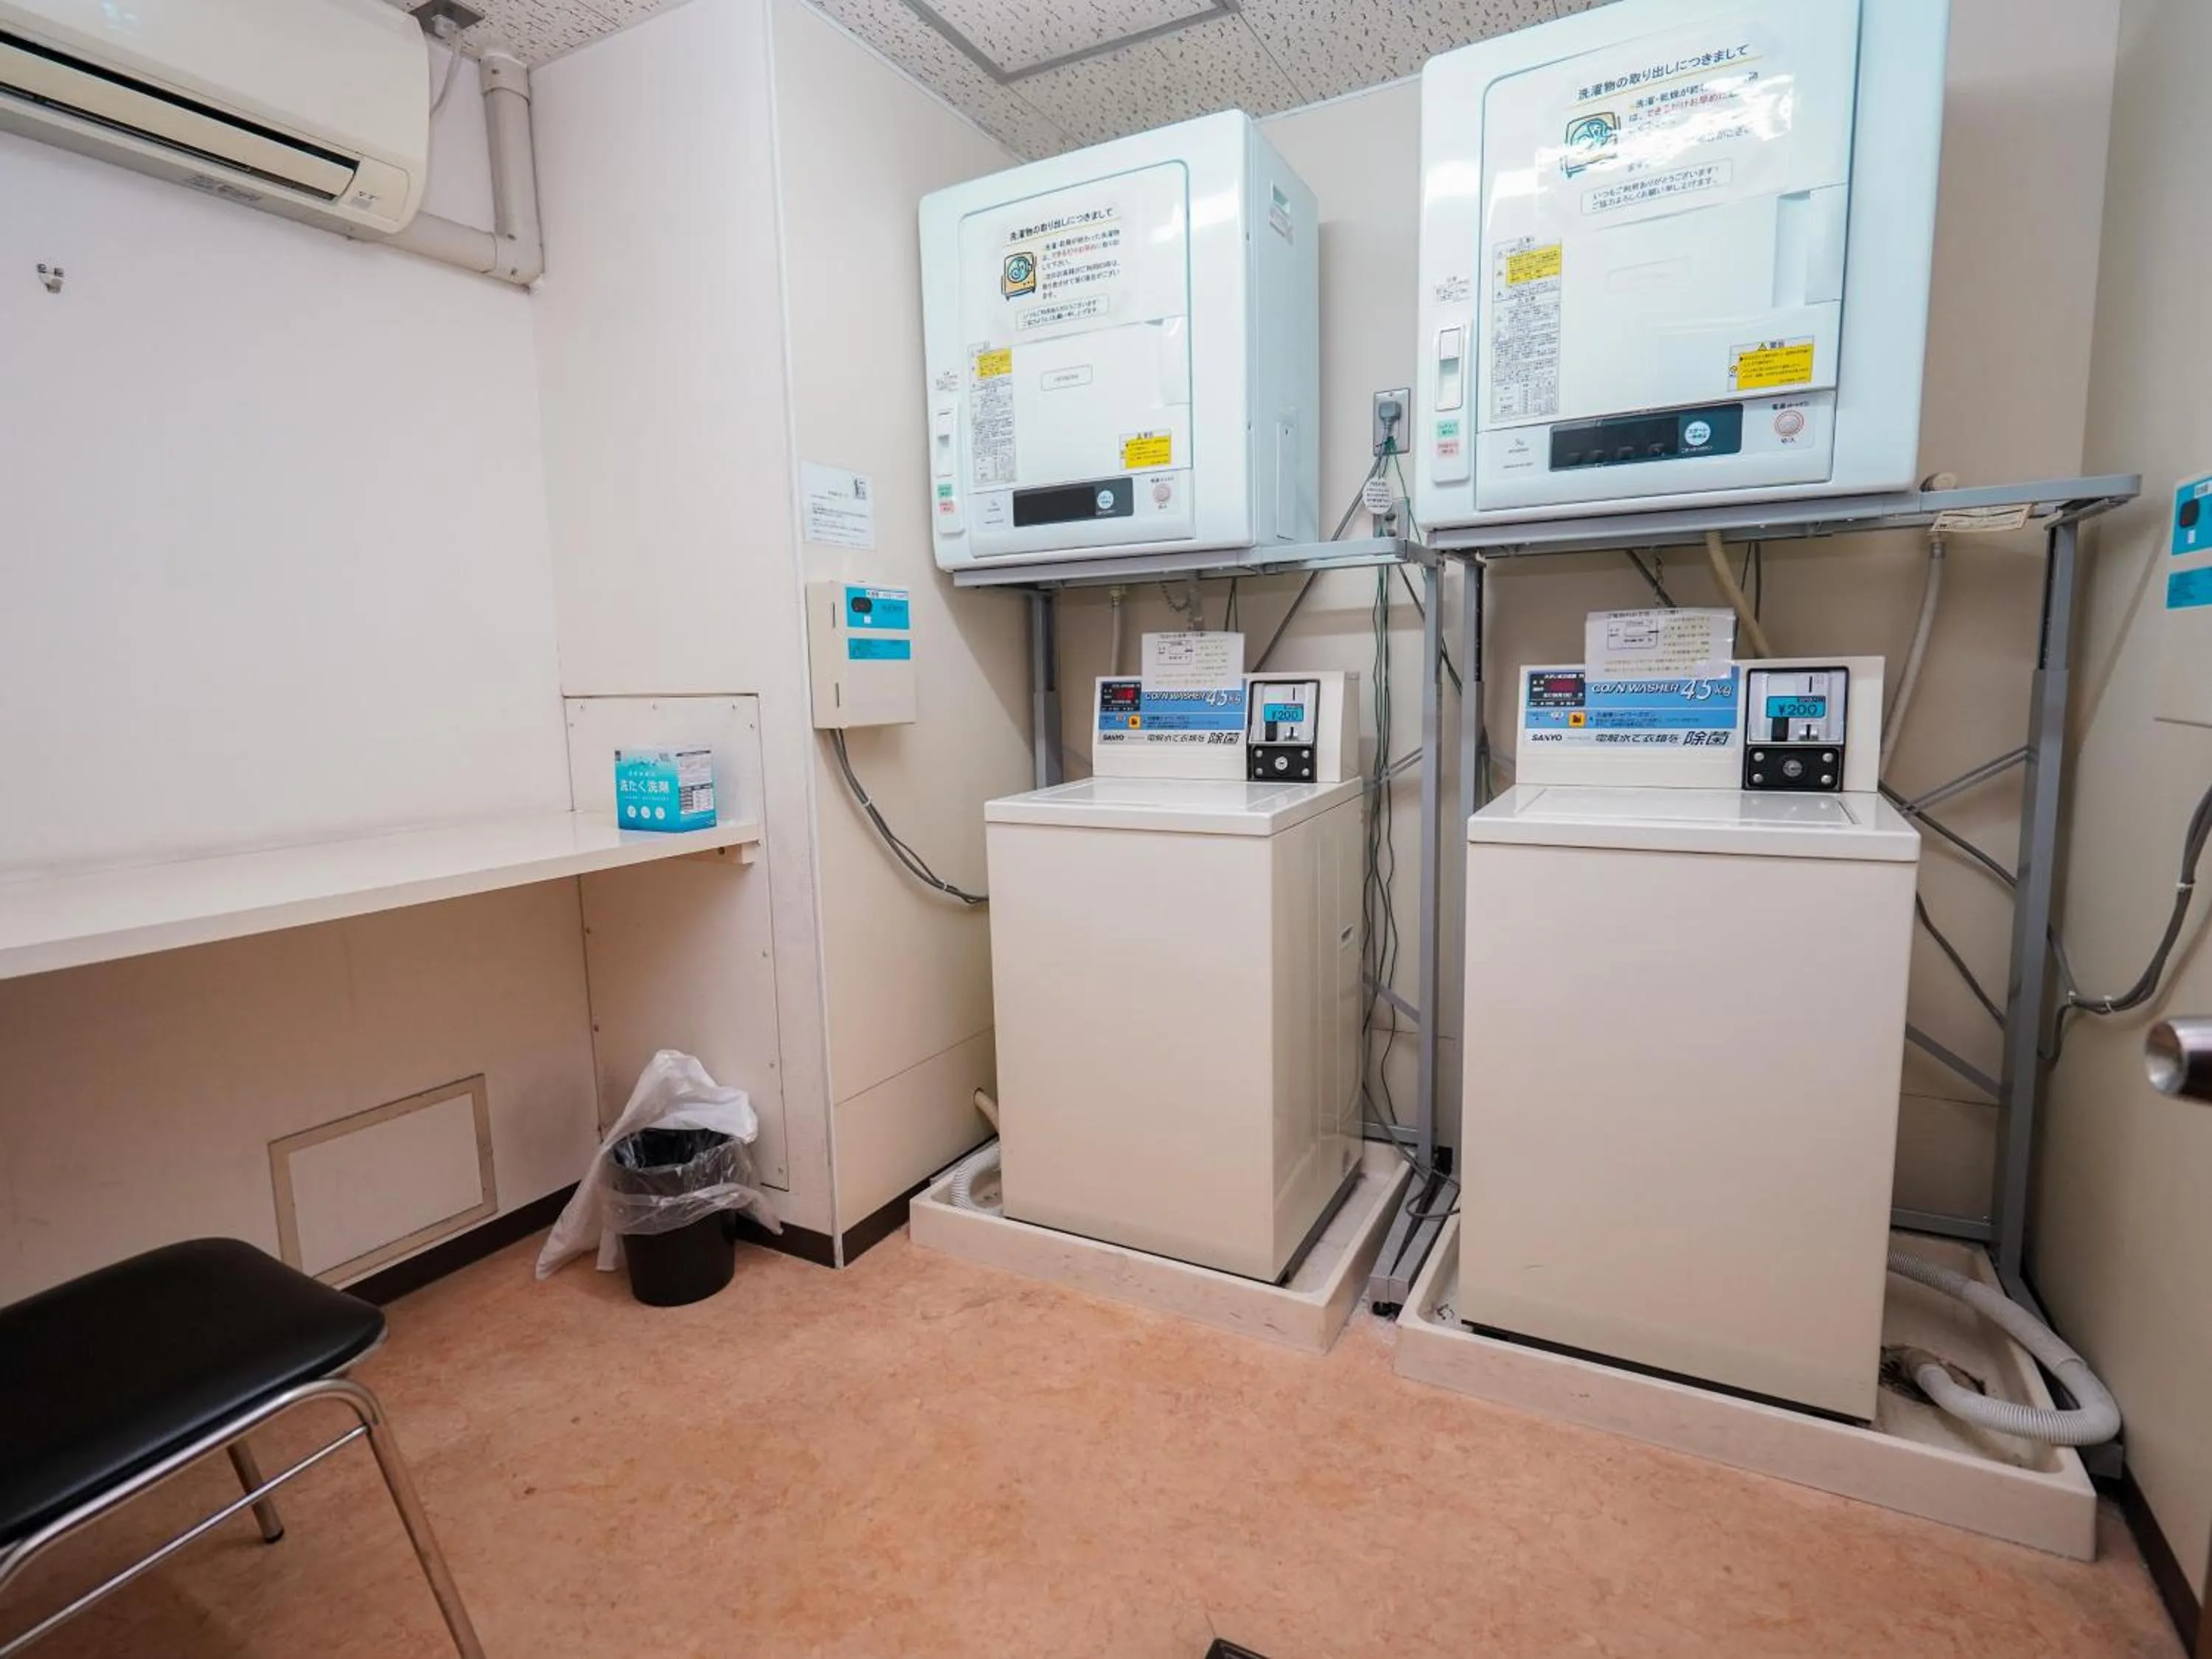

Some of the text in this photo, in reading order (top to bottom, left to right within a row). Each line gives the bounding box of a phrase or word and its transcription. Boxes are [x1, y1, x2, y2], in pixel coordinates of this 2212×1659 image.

[1577, 44, 1750, 101] 洗濯物の取り出しにつきまして
[1010, 207, 1113, 241] 洗濯物の取り出しにつきまして
[1628, 683, 1680, 694] WASHER
[1778, 703, 1818, 716] ¥200
[1595, 731, 1731, 746] 電解水で衣類を 除菌
